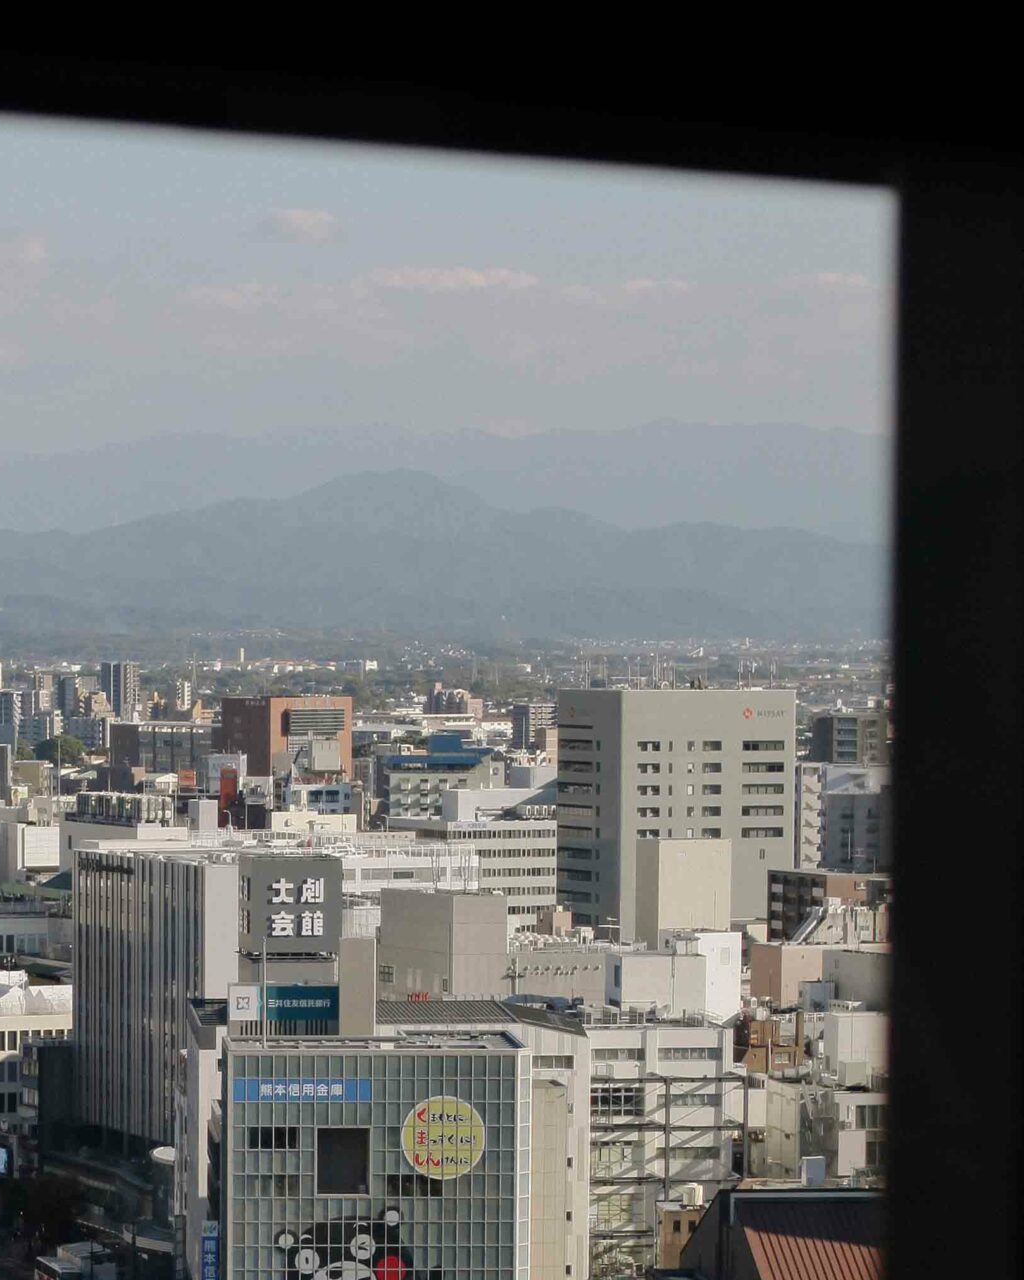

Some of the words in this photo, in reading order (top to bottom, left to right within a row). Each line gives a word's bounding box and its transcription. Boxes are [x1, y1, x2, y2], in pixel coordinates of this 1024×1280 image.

[272, 878, 324, 903] 大劇
[271, 910, 324, 936] 会館
[260, 1083, 343, 1096] 熊本信用金庫
